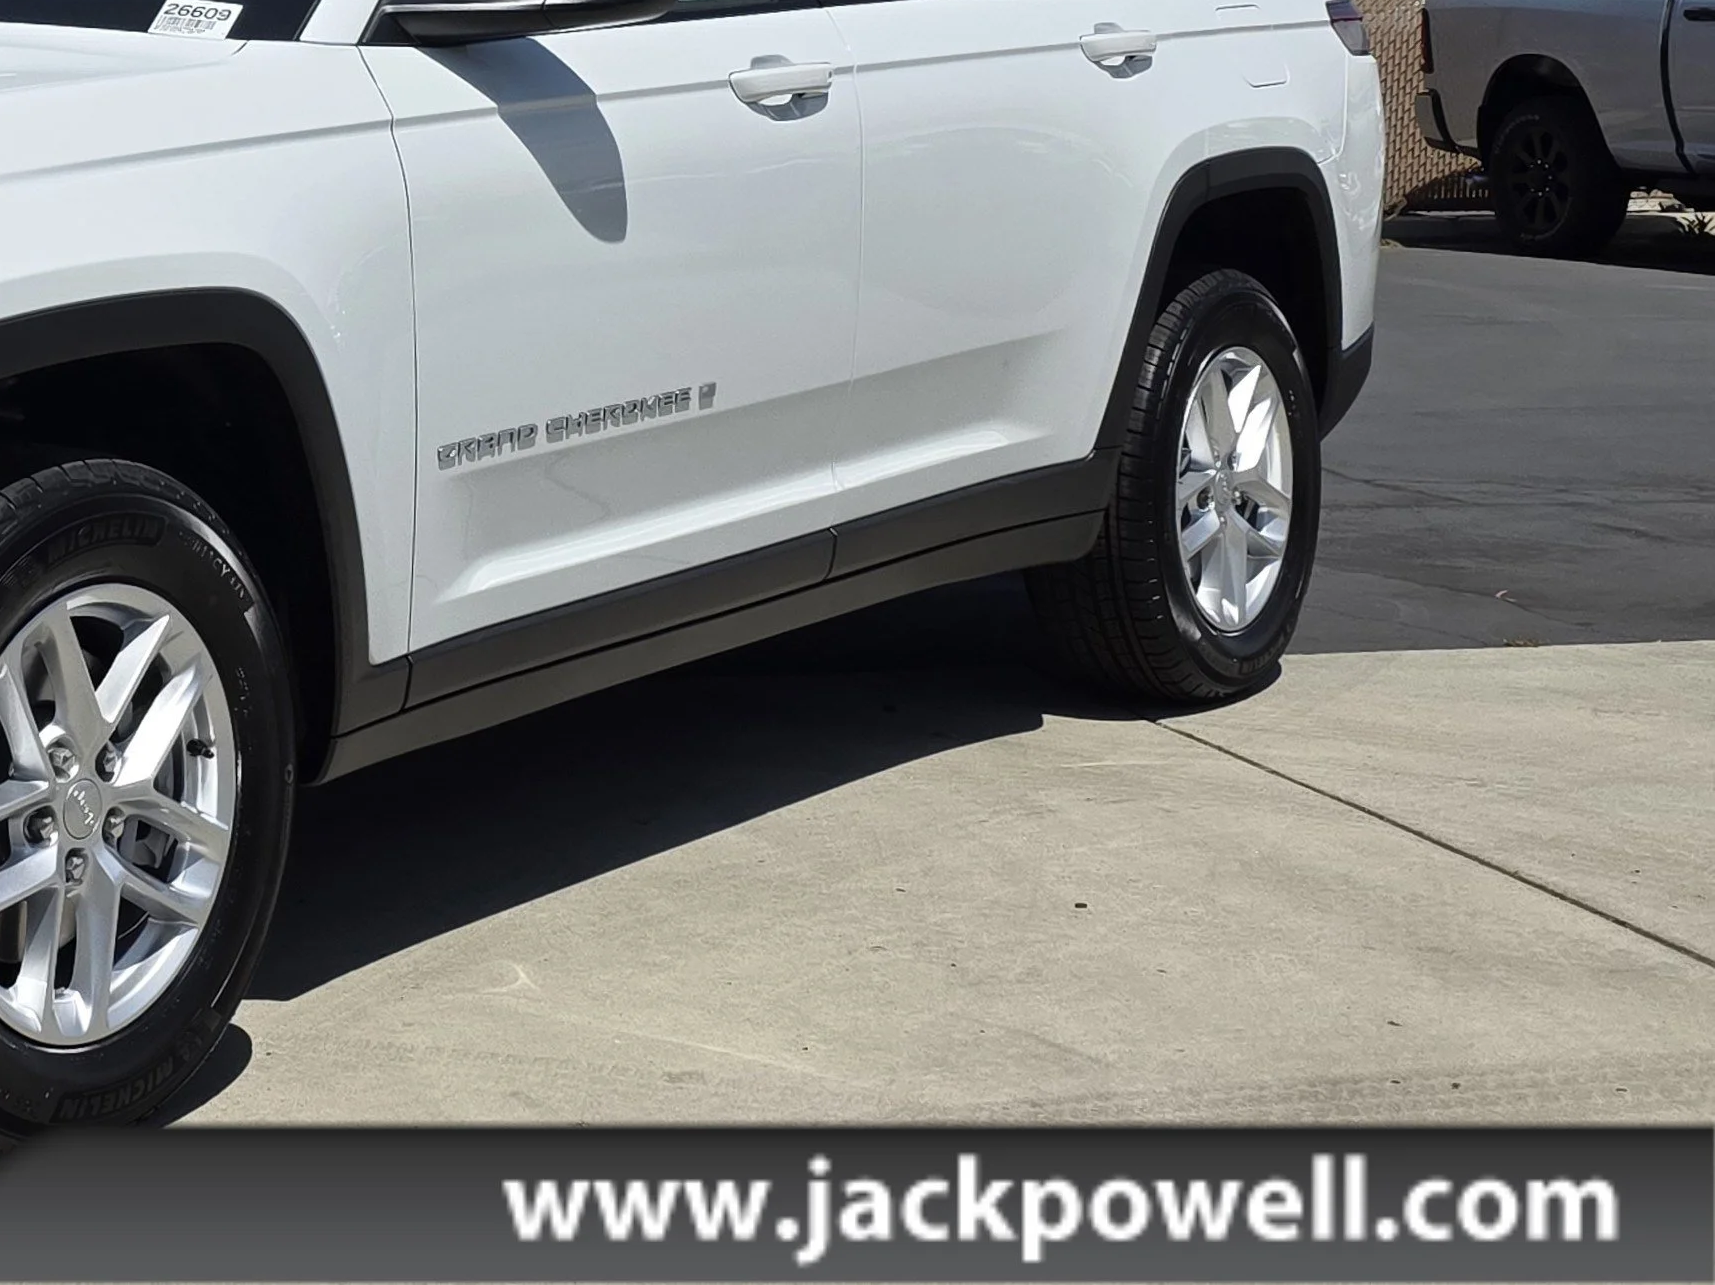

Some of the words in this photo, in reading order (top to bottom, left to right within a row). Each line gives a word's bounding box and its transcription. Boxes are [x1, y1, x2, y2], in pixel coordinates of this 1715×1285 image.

[163, 3, 232, 22] 26609
[436, 423, 539, 472] GRAND
[544, 386, 693, 444] CHEROKEE
